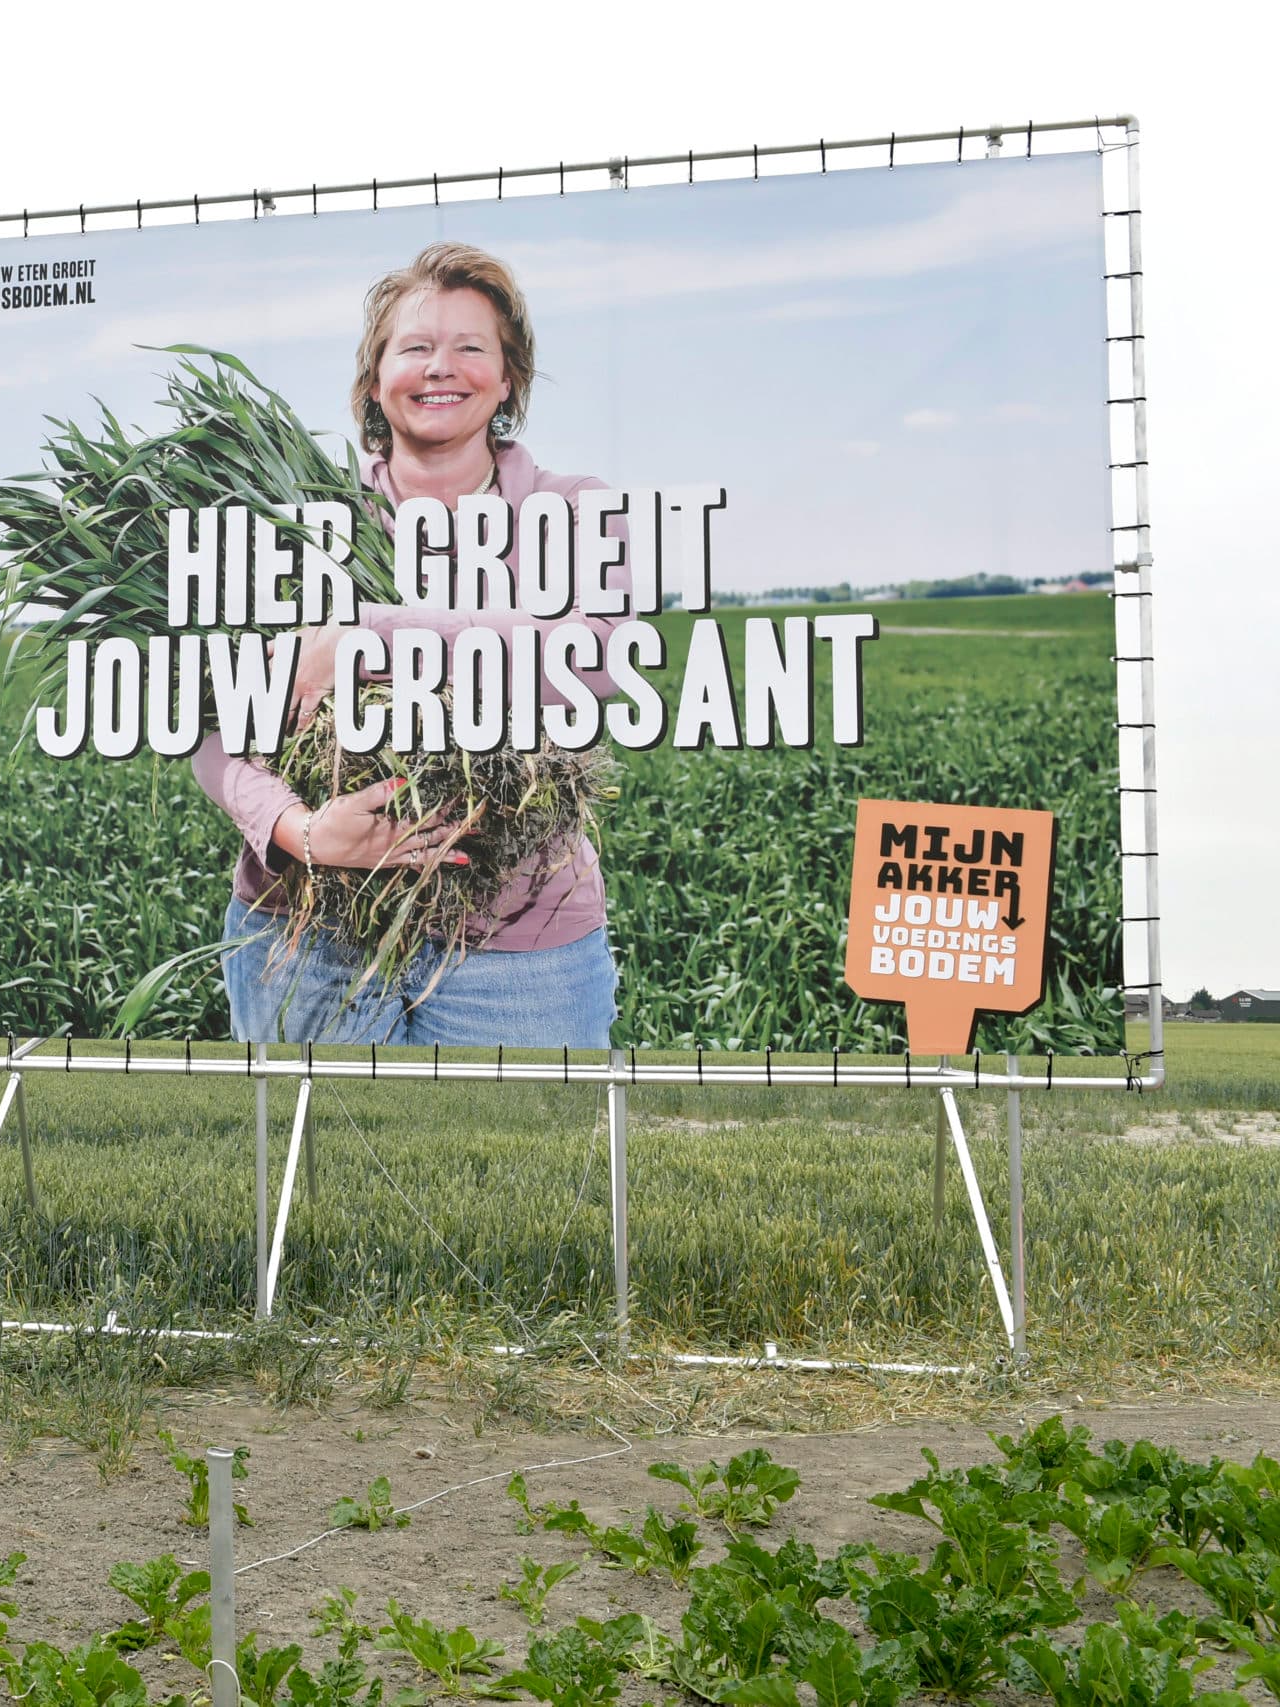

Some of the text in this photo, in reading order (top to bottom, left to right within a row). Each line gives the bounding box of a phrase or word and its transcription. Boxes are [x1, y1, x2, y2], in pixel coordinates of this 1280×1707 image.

[18, 263, 48, 282] ETEN
[52, 259, 96, 280] GROEIT
[167, 486, 727, 628] HIER GROEIT
[36, 613, 878, 760] JOUW CROISSANT
[879, 822, 1024, 867] MIJN
[877, 861, 1021, 898] AKKER
[874, 893, 999, 931] JOUW
[872, 925, 1017, 955] VOEDINGS
[870, 946, 1016, 986] BODEM
